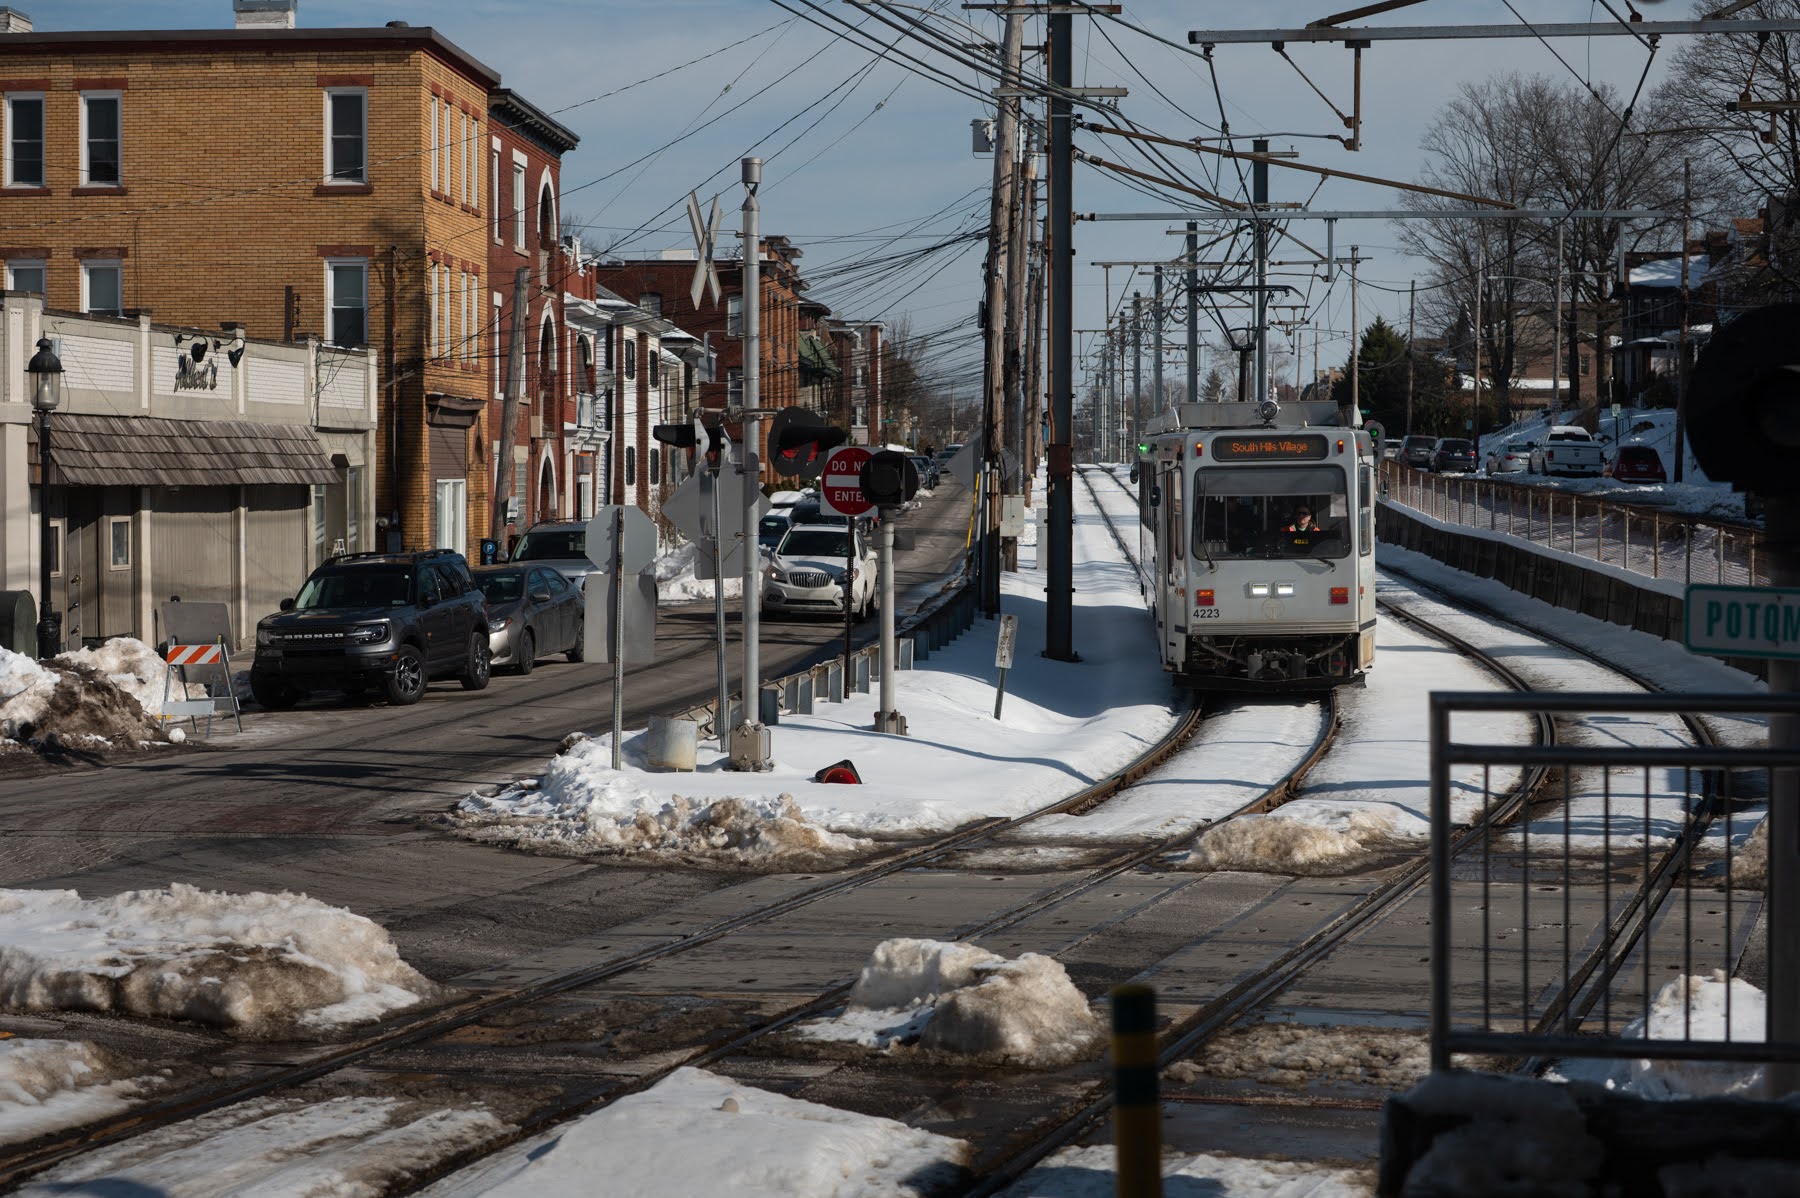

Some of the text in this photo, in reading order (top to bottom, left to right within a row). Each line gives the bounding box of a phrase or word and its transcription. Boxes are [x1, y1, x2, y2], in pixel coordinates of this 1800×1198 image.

[1232, 441, 1308, 454] South Hills Village
[832, 460, 847, 471] DO
[834, 490, 866, 502] ENTE
[1193, 608, 1220, 619] 4223
